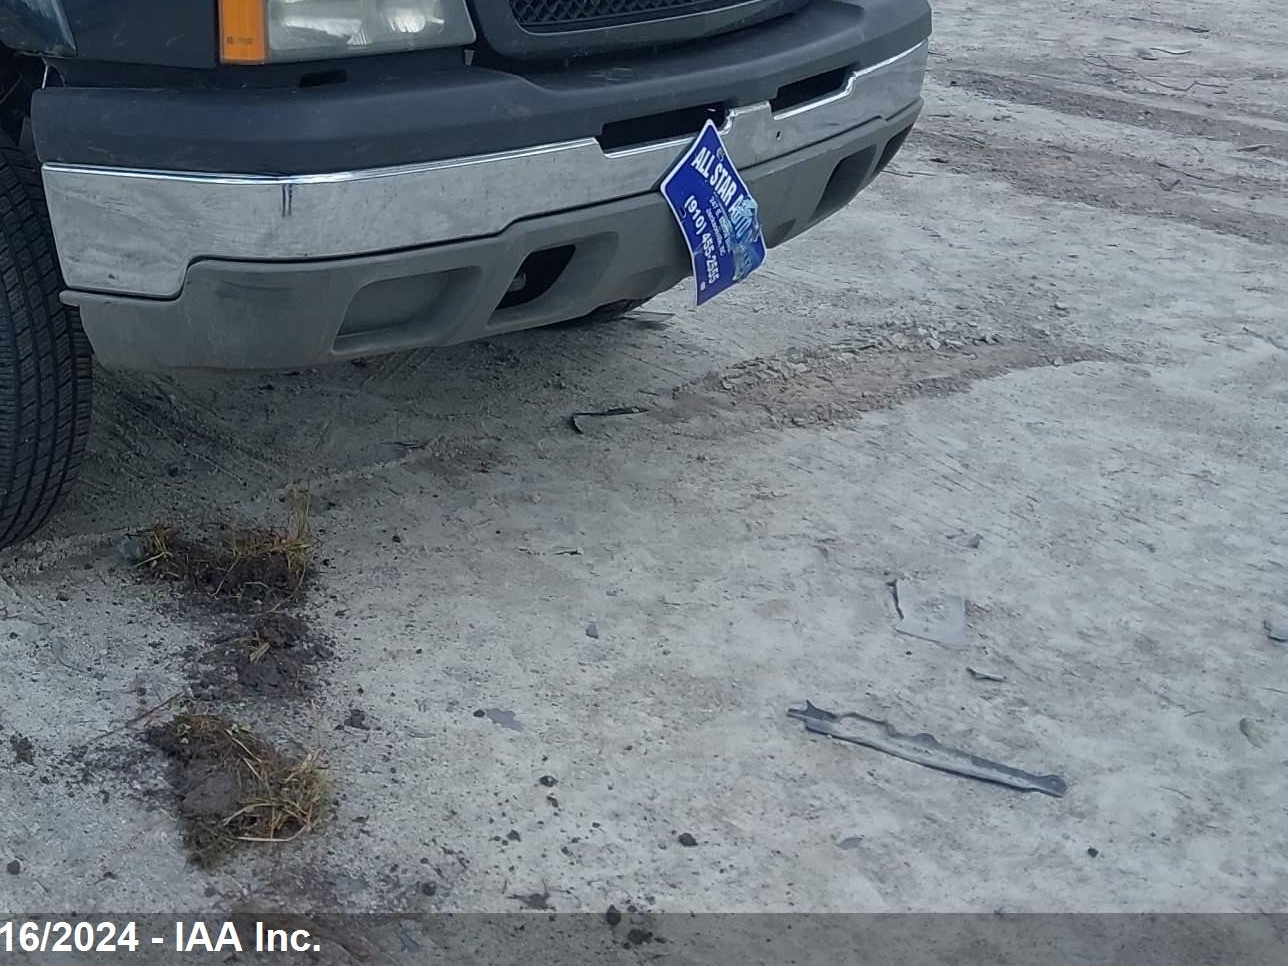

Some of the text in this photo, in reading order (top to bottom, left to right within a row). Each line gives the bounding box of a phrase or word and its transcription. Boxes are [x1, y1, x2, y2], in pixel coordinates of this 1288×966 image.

[691, 146, 715, 179] ALL
[709, 164, 737, 206] STAR
[684, 195, 719, 284] (910) 455-2555
